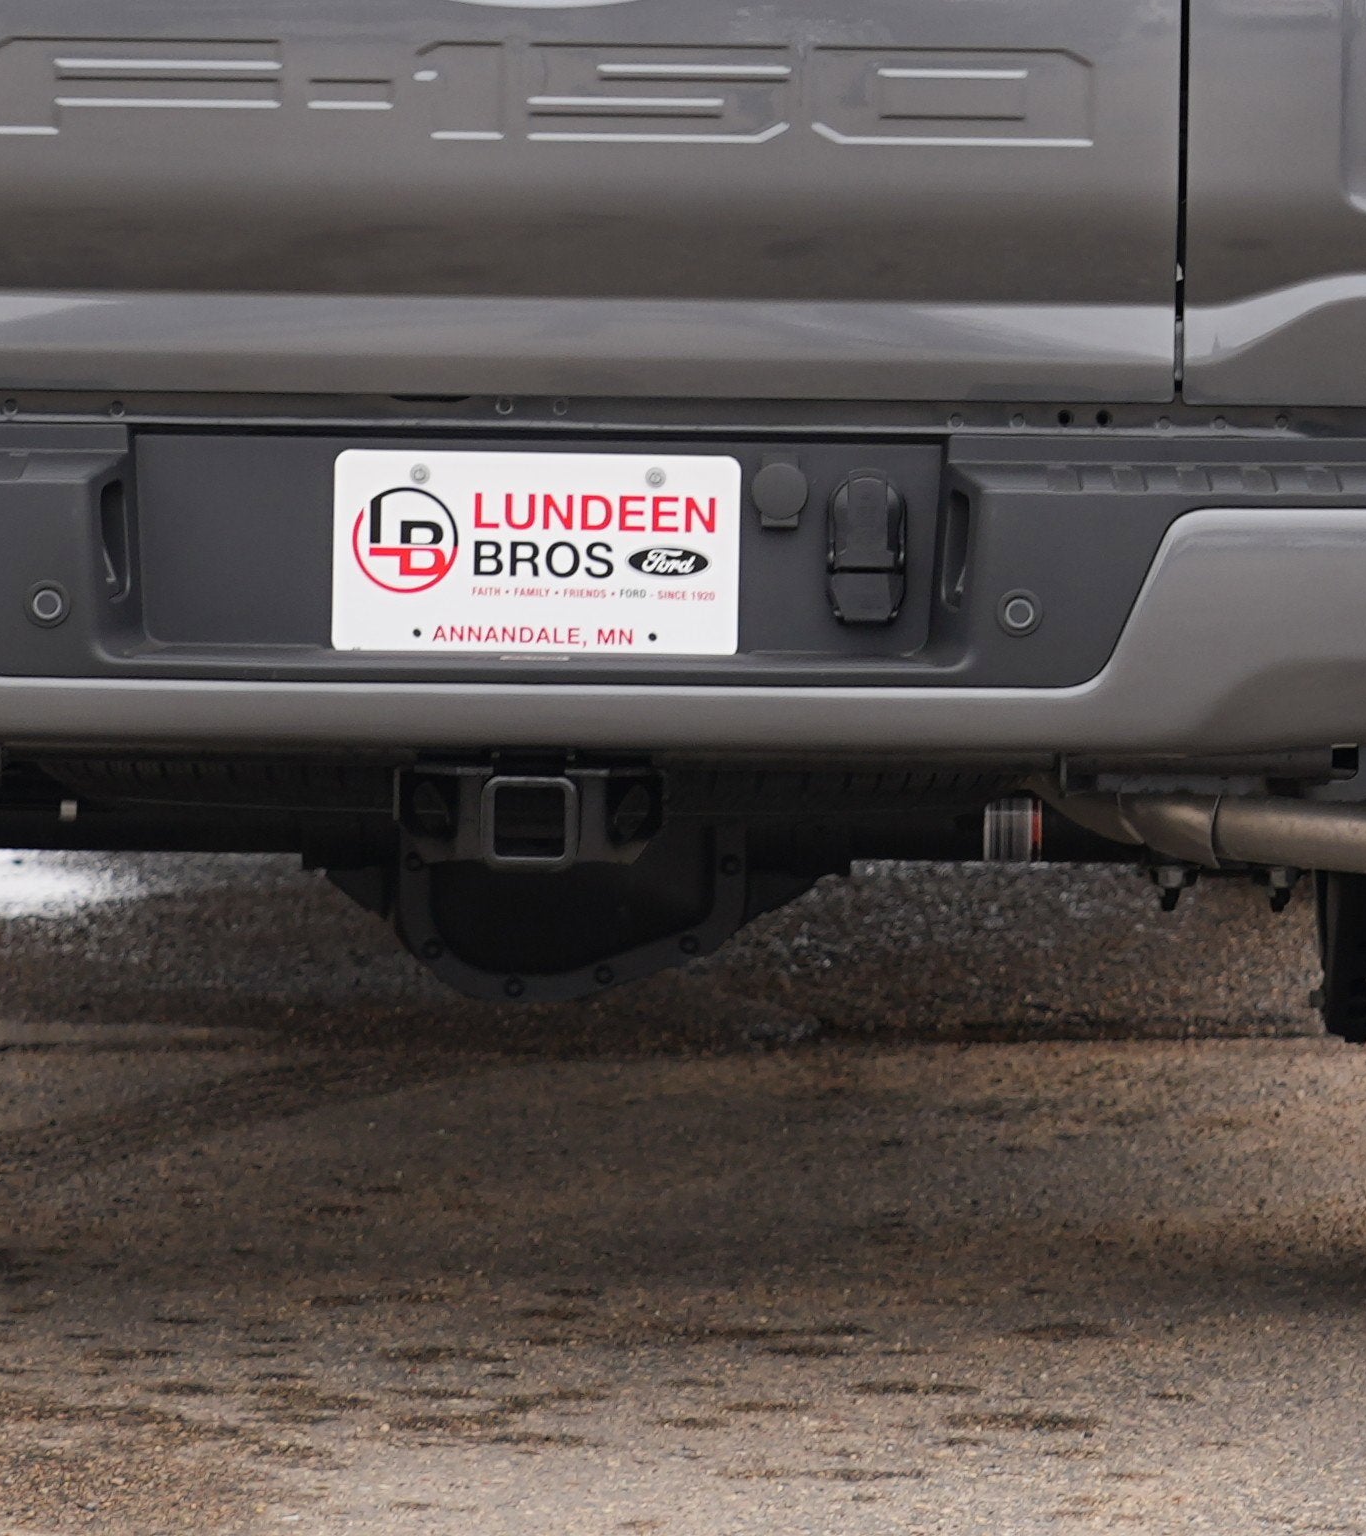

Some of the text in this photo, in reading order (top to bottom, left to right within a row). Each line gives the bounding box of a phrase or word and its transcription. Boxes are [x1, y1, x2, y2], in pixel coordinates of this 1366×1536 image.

[473, 492, 717, 533] LUNDEEN
[473, 540, 698, 579] BROS Ford
[472, 586, 716, 602] FAITH FAMILY FRIENDS FORD SINCE 1920
[432, 625, 634, 648] ANNANDALE, MN
